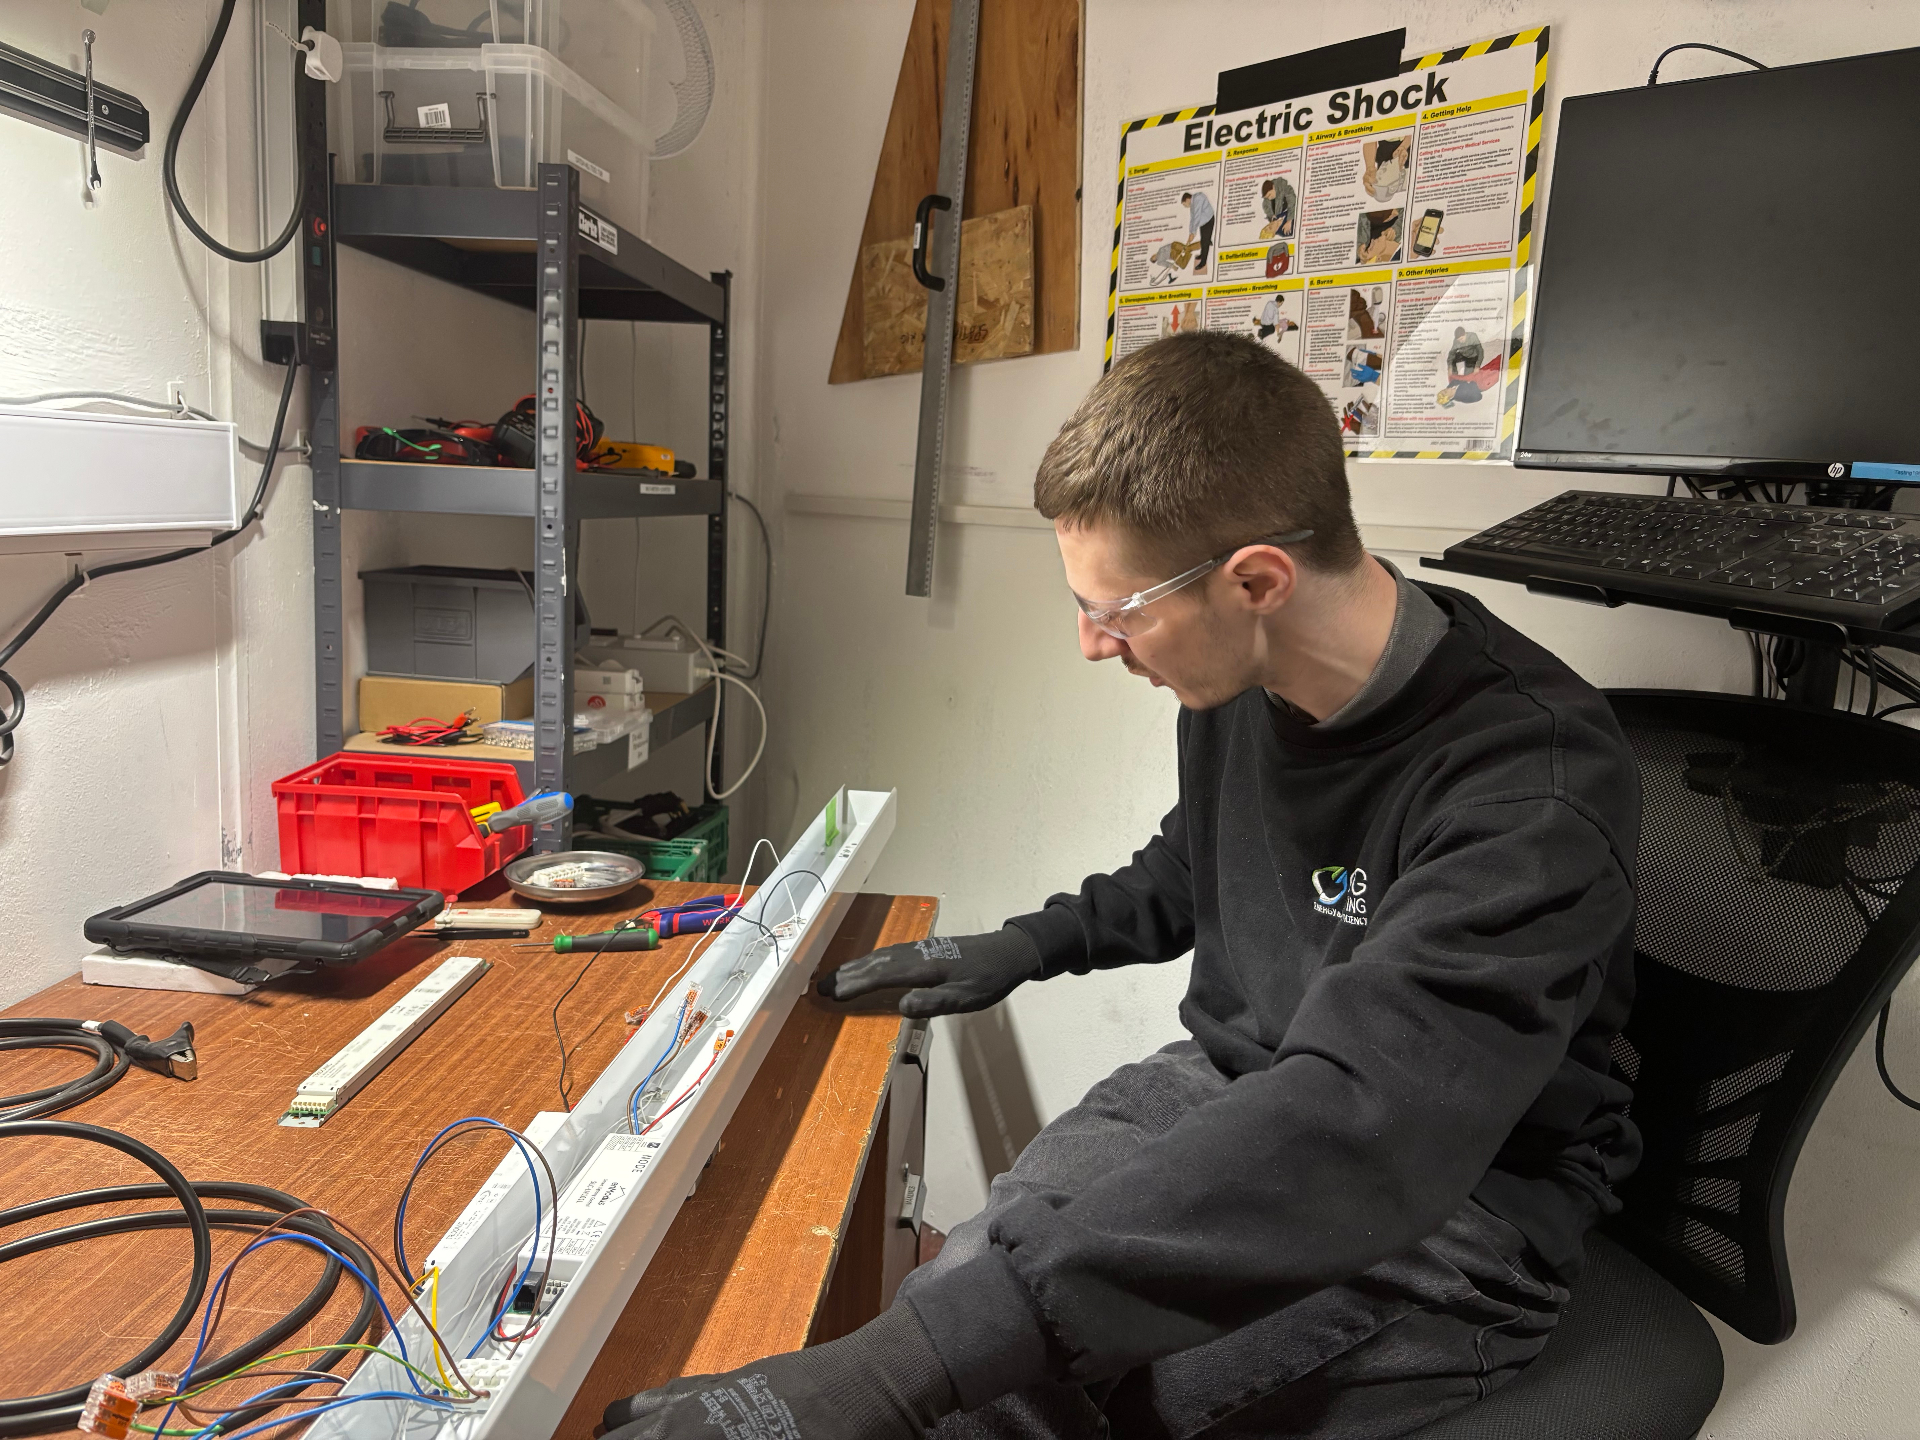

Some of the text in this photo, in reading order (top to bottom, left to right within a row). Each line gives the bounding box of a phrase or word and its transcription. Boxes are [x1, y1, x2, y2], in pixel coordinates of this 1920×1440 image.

[1184, 72, 1450, 153] Electric Shock
[1431, 109, 1454, 119] Getting
[1456, 105, 1472, 113] Help
[1315, 132, 1336, 141] Airway
[1344, 125, 1373, 135] Breathing
[1233, 147, 1258, 157] Response
[1134, 166, 1150, 175] Danger
[1225, 252, 1258, 260] Defibrillation
[1425, 267, 1449, 275] Injuries
[1213, 286, 1248, 295] Unresponsive
[1252, 284, 1278, 292] Breathing
[1168, 292, 1192, 300] Breathing
[1829, 463, 1843, 477] hp
[632, 1154, 652, 1173] NODE
